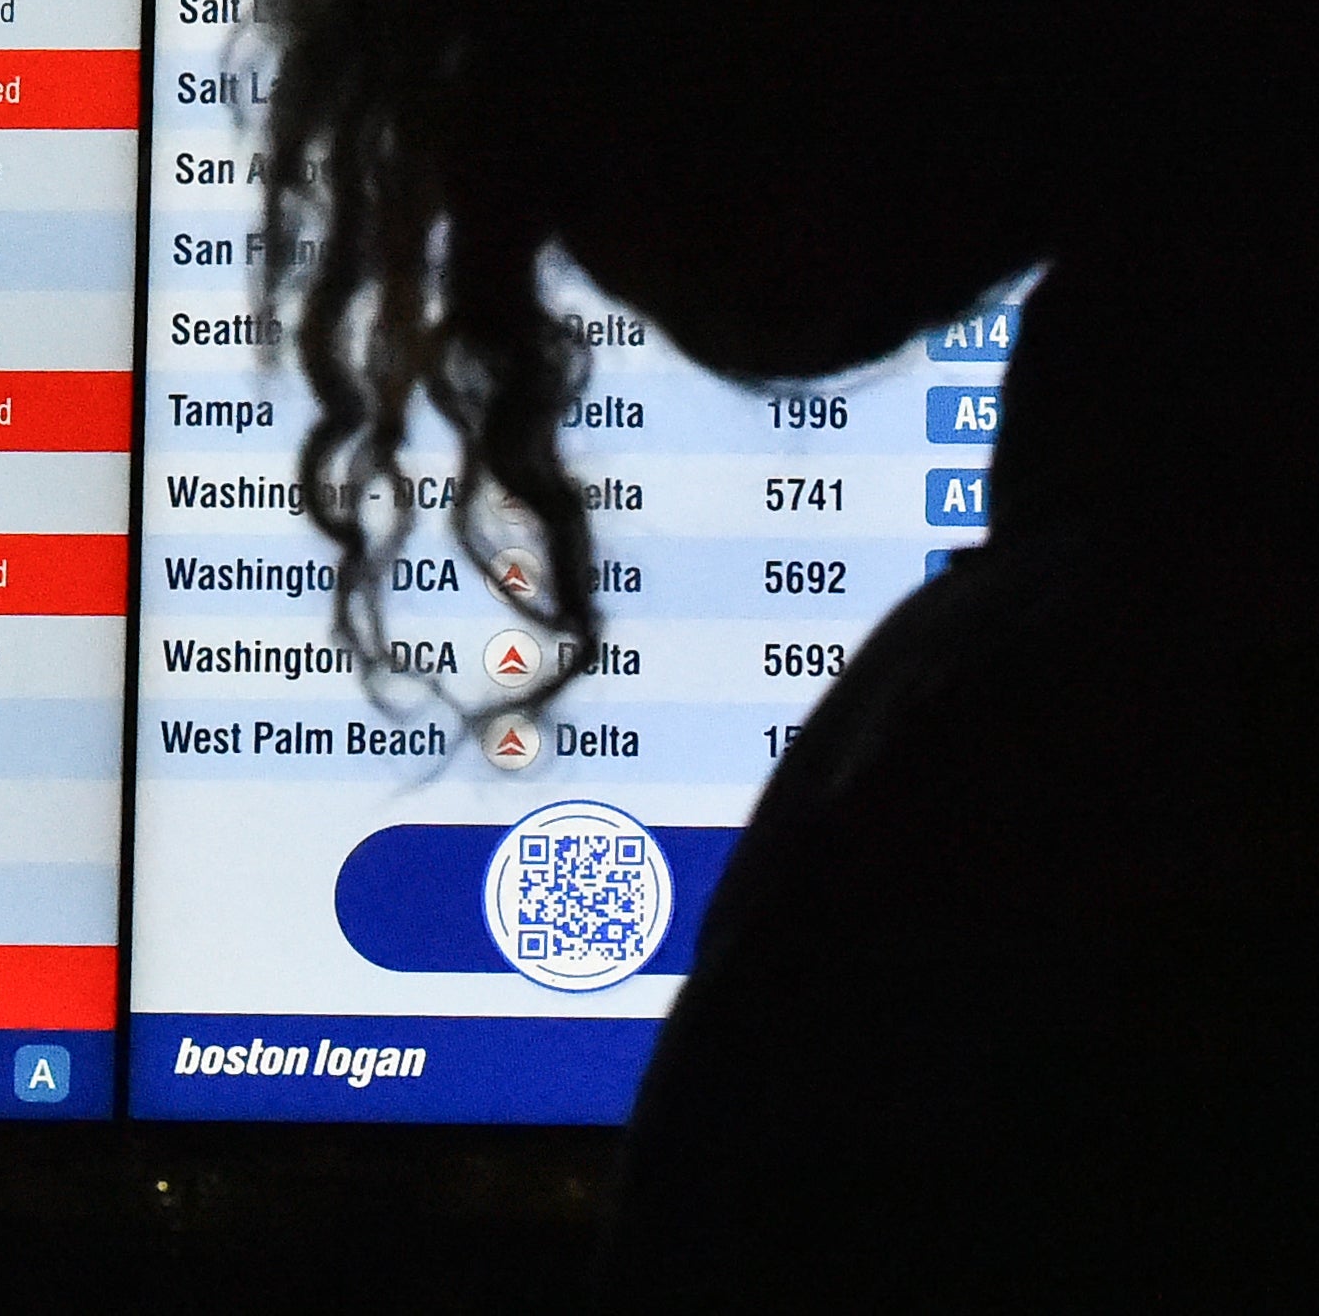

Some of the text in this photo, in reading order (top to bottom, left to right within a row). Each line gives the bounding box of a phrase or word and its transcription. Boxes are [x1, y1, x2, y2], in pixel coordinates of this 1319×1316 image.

[168, 393, 274, 434] Tampa
[767, 394, 848, 430] 1996
[953, 395, 998, 432] A5
[162, 639, 845, 680] Washington DCA 5693
[160, 720, 639, 758] West Palm Beach Delta
[27, 1058, 56, 1090] A
[173, 1036, 427, 1089] boston logan
